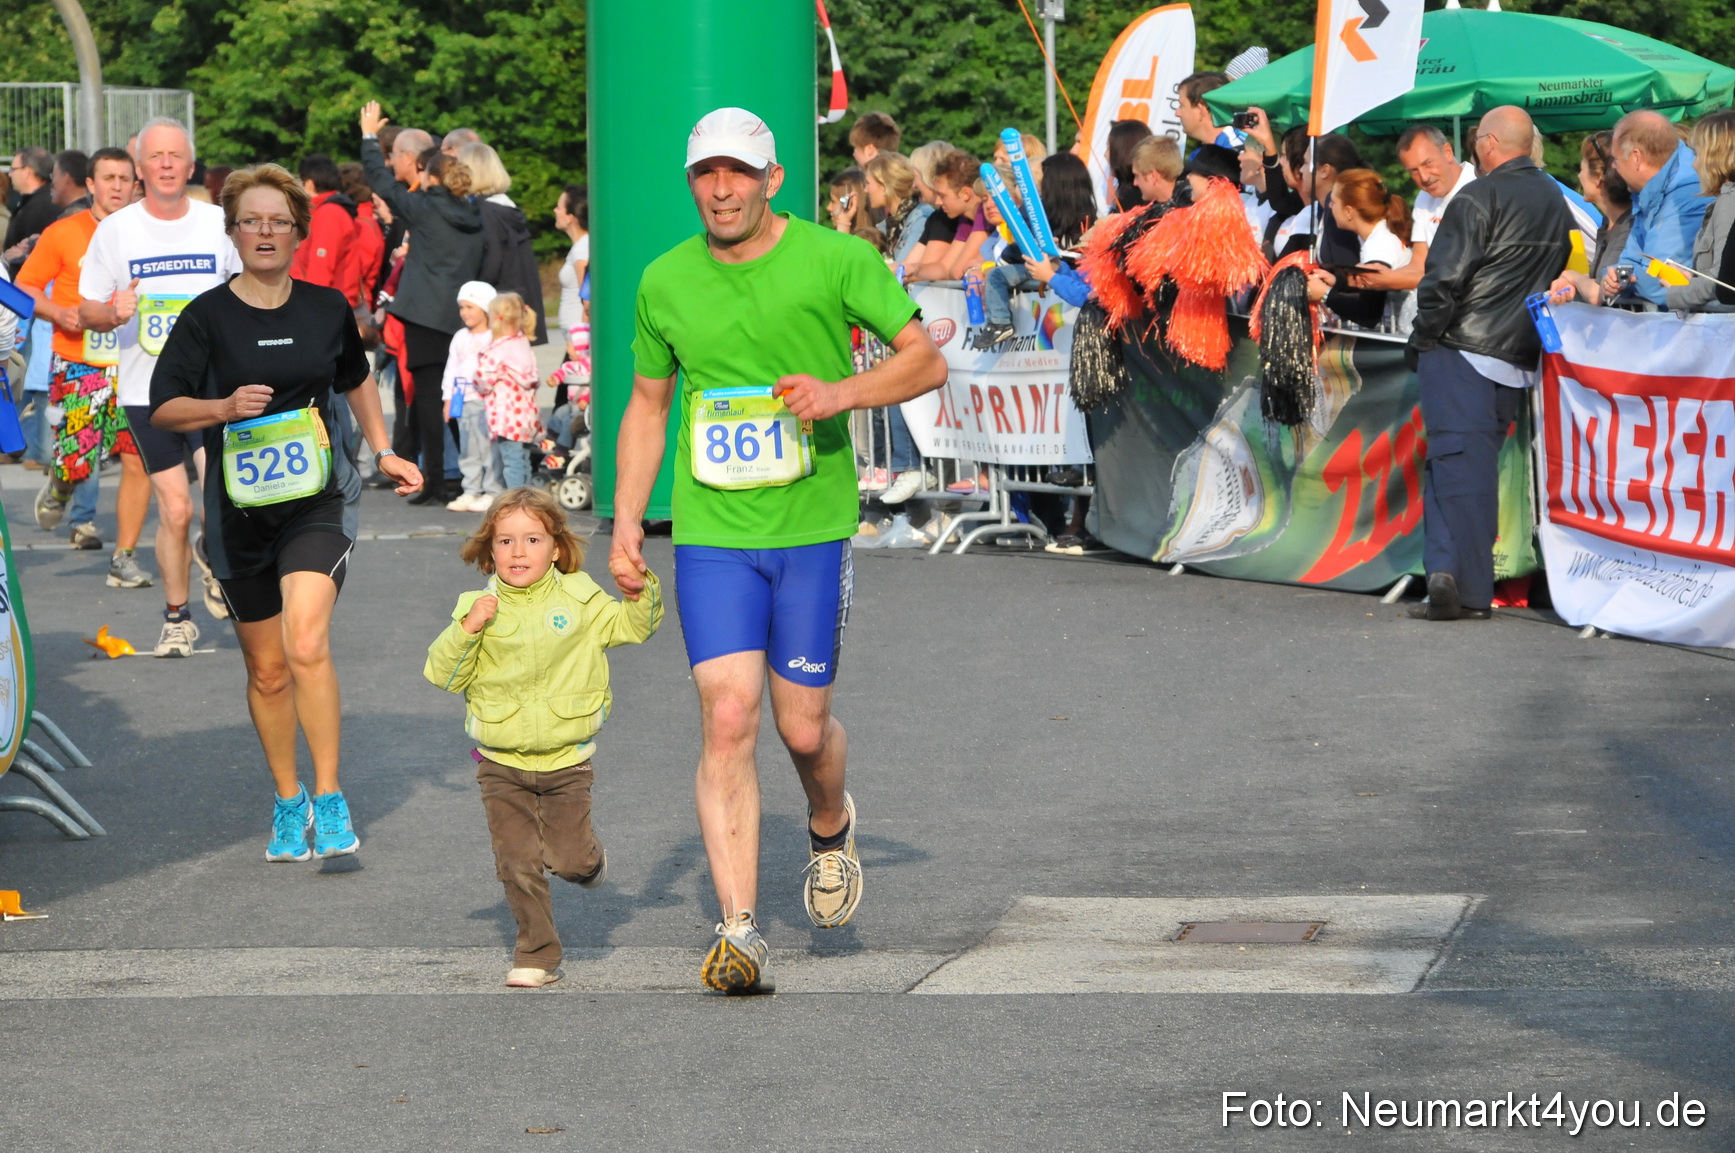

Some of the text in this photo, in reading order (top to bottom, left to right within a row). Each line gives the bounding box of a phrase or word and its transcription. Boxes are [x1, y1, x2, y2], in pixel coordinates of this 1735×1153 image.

[1538, 78, 1604, 92] Neumarkter
[1525, 90, 1613, 107] Lammsbräu
[142, 258, 212, 274] STAEDTLER
[961, 326, 1038, 353] Frhmann
[934, 381, 1064, 434] XL-PRINT
[706, 421, 783, 463] 861
[236, 441, 309, 486] 528
[726, 464, 754, 474] Franz
[254, 482, 286, 493] Daniela
